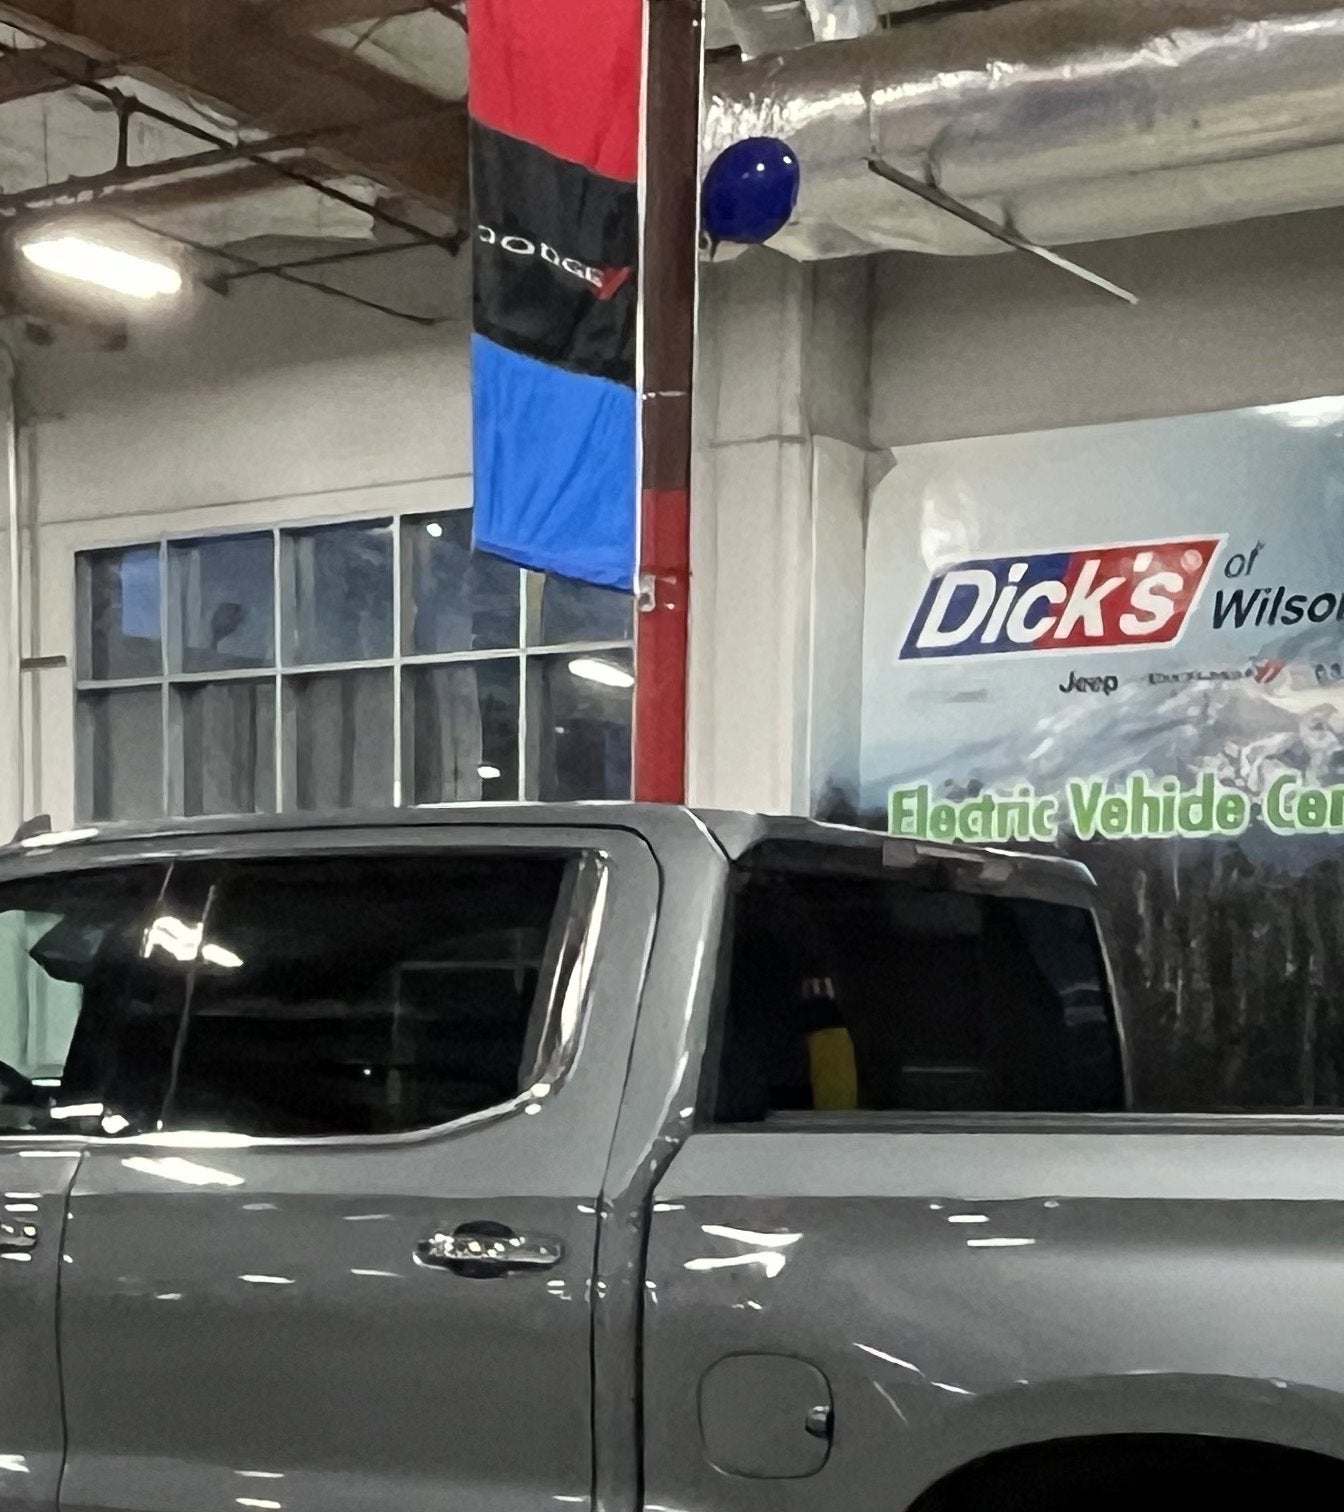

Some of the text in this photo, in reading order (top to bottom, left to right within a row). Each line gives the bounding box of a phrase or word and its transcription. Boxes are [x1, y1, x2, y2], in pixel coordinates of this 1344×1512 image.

[915, 540, 1265, 649] Dick's of
[887, 784, 1057, 842] Electric
[1068, 769, 1249, 840] Vehicle
